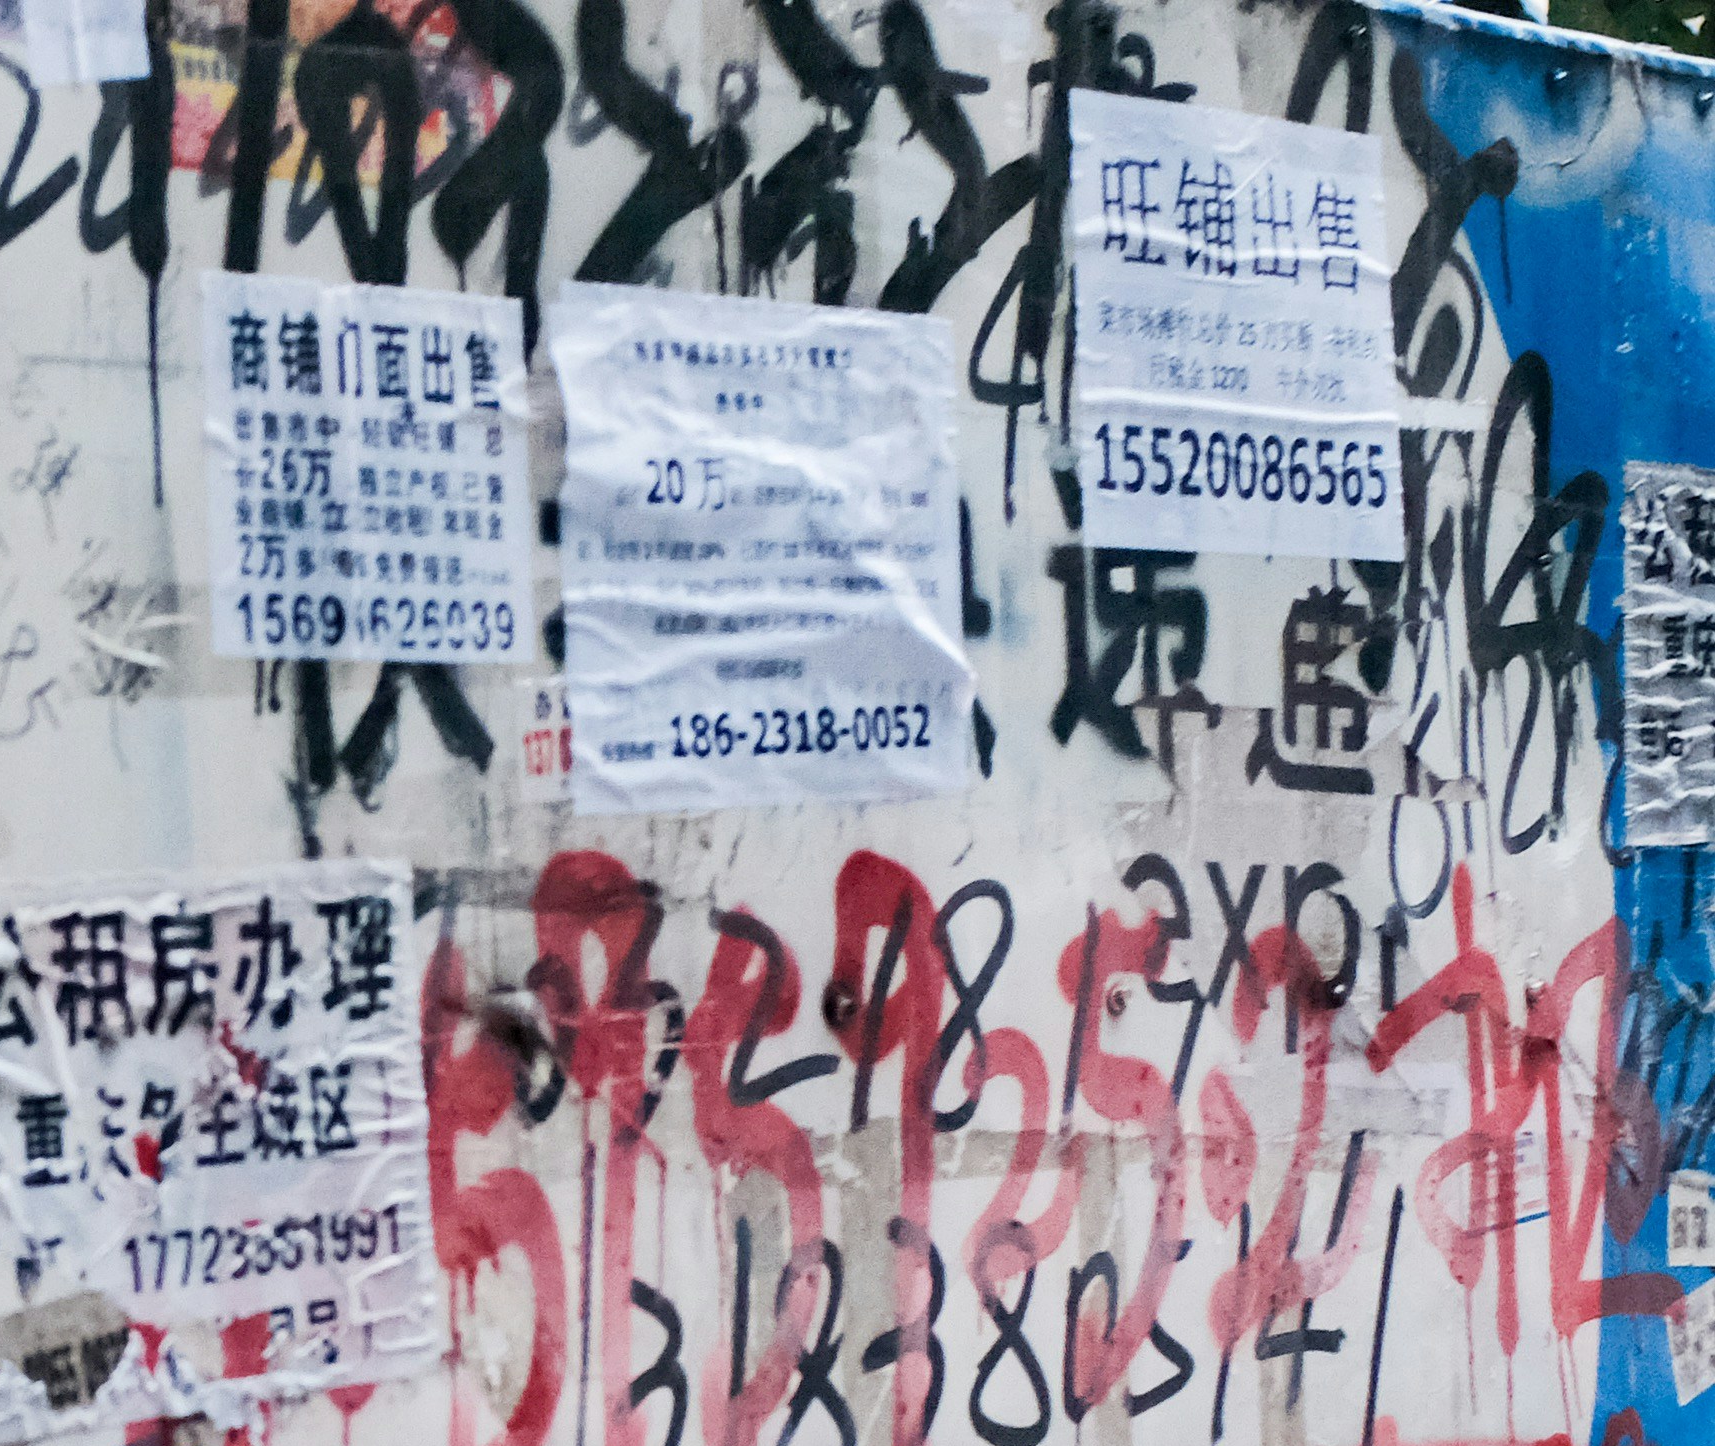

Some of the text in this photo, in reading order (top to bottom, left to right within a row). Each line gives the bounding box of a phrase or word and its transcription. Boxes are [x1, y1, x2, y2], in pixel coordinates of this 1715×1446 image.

[1100, 157, 1361, 295] 旺铺出售
[227, 307, 501, 411] 商铺门面出售
[645, 457, 686, 506] 20
[1094, 421, 1389, 509] 15520086565
[670, 702, 932, 759] 186-2318-0052
